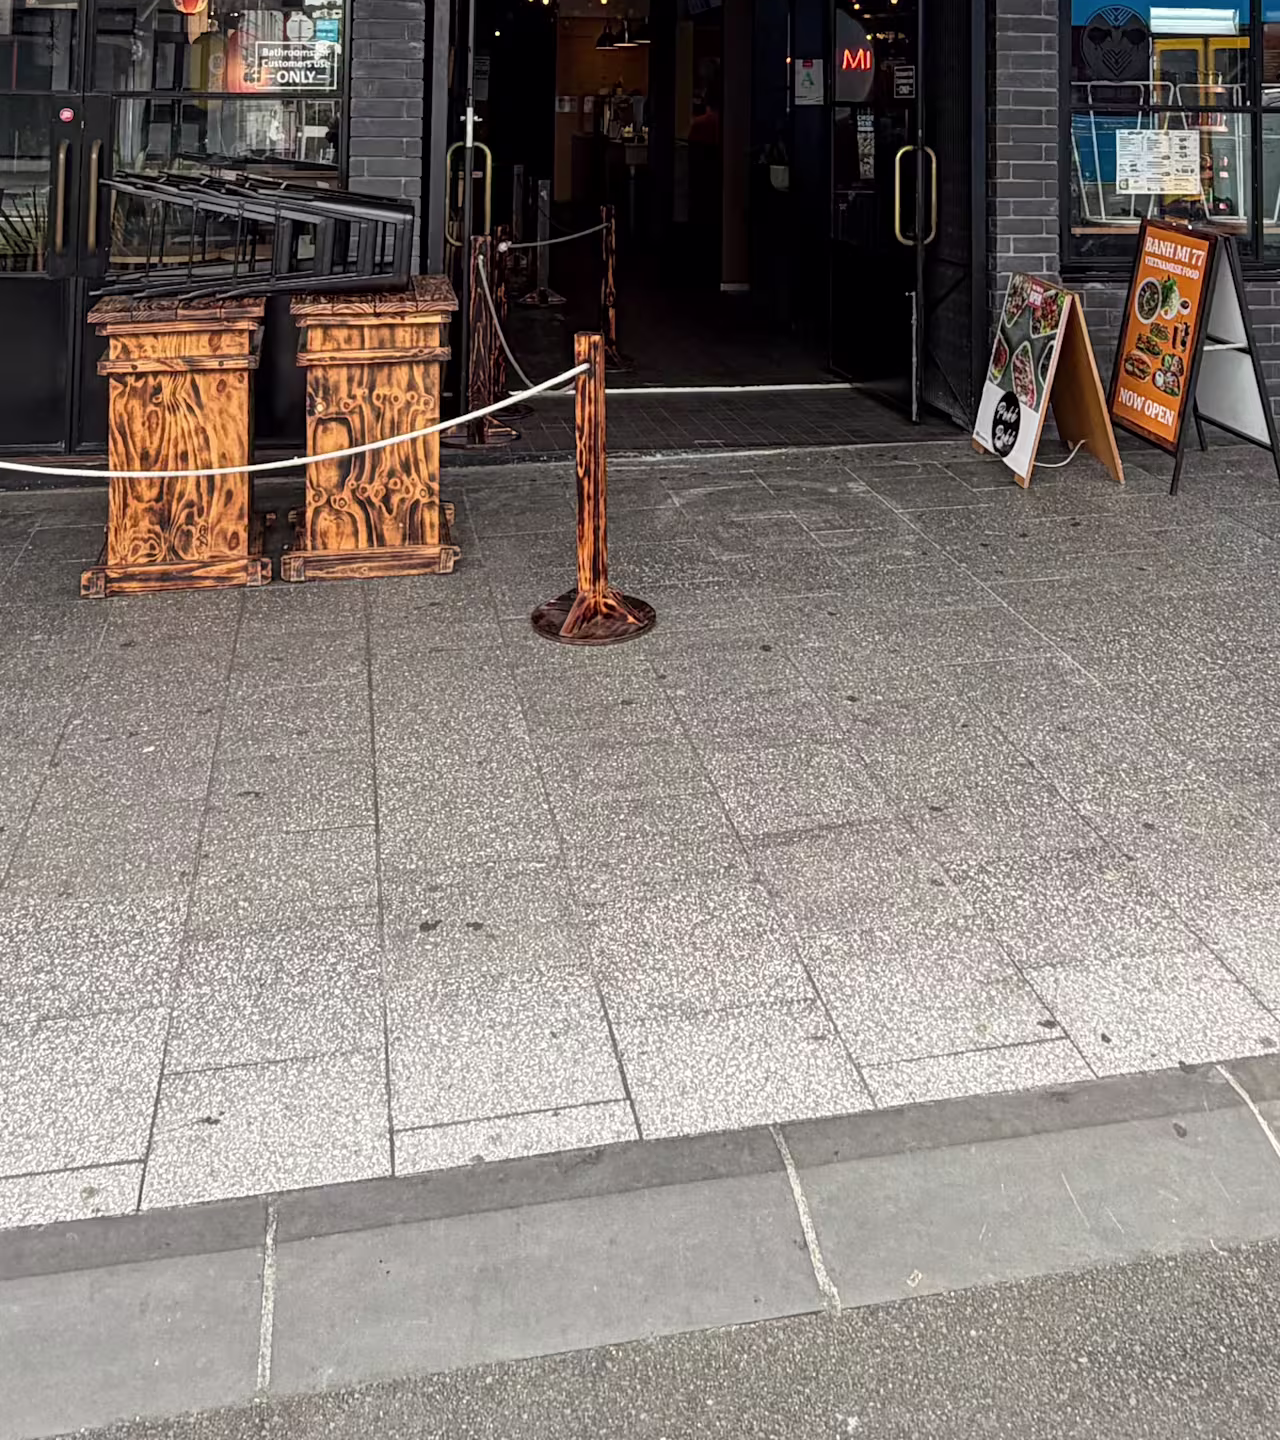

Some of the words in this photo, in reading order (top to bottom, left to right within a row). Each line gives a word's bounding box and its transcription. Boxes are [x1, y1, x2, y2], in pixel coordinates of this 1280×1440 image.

[276, 71, 316, 83] ONLY
[1145, 236, 1175, 263] BANH
[1174, 244, 1191, 263] MI
[1191, 248, 1206, 267] 77
[1182, 267, 1200, 280] FOOD
[1118, 387, 1144, 411] NOW
[1144, 400, 1176, 426] OPEN
